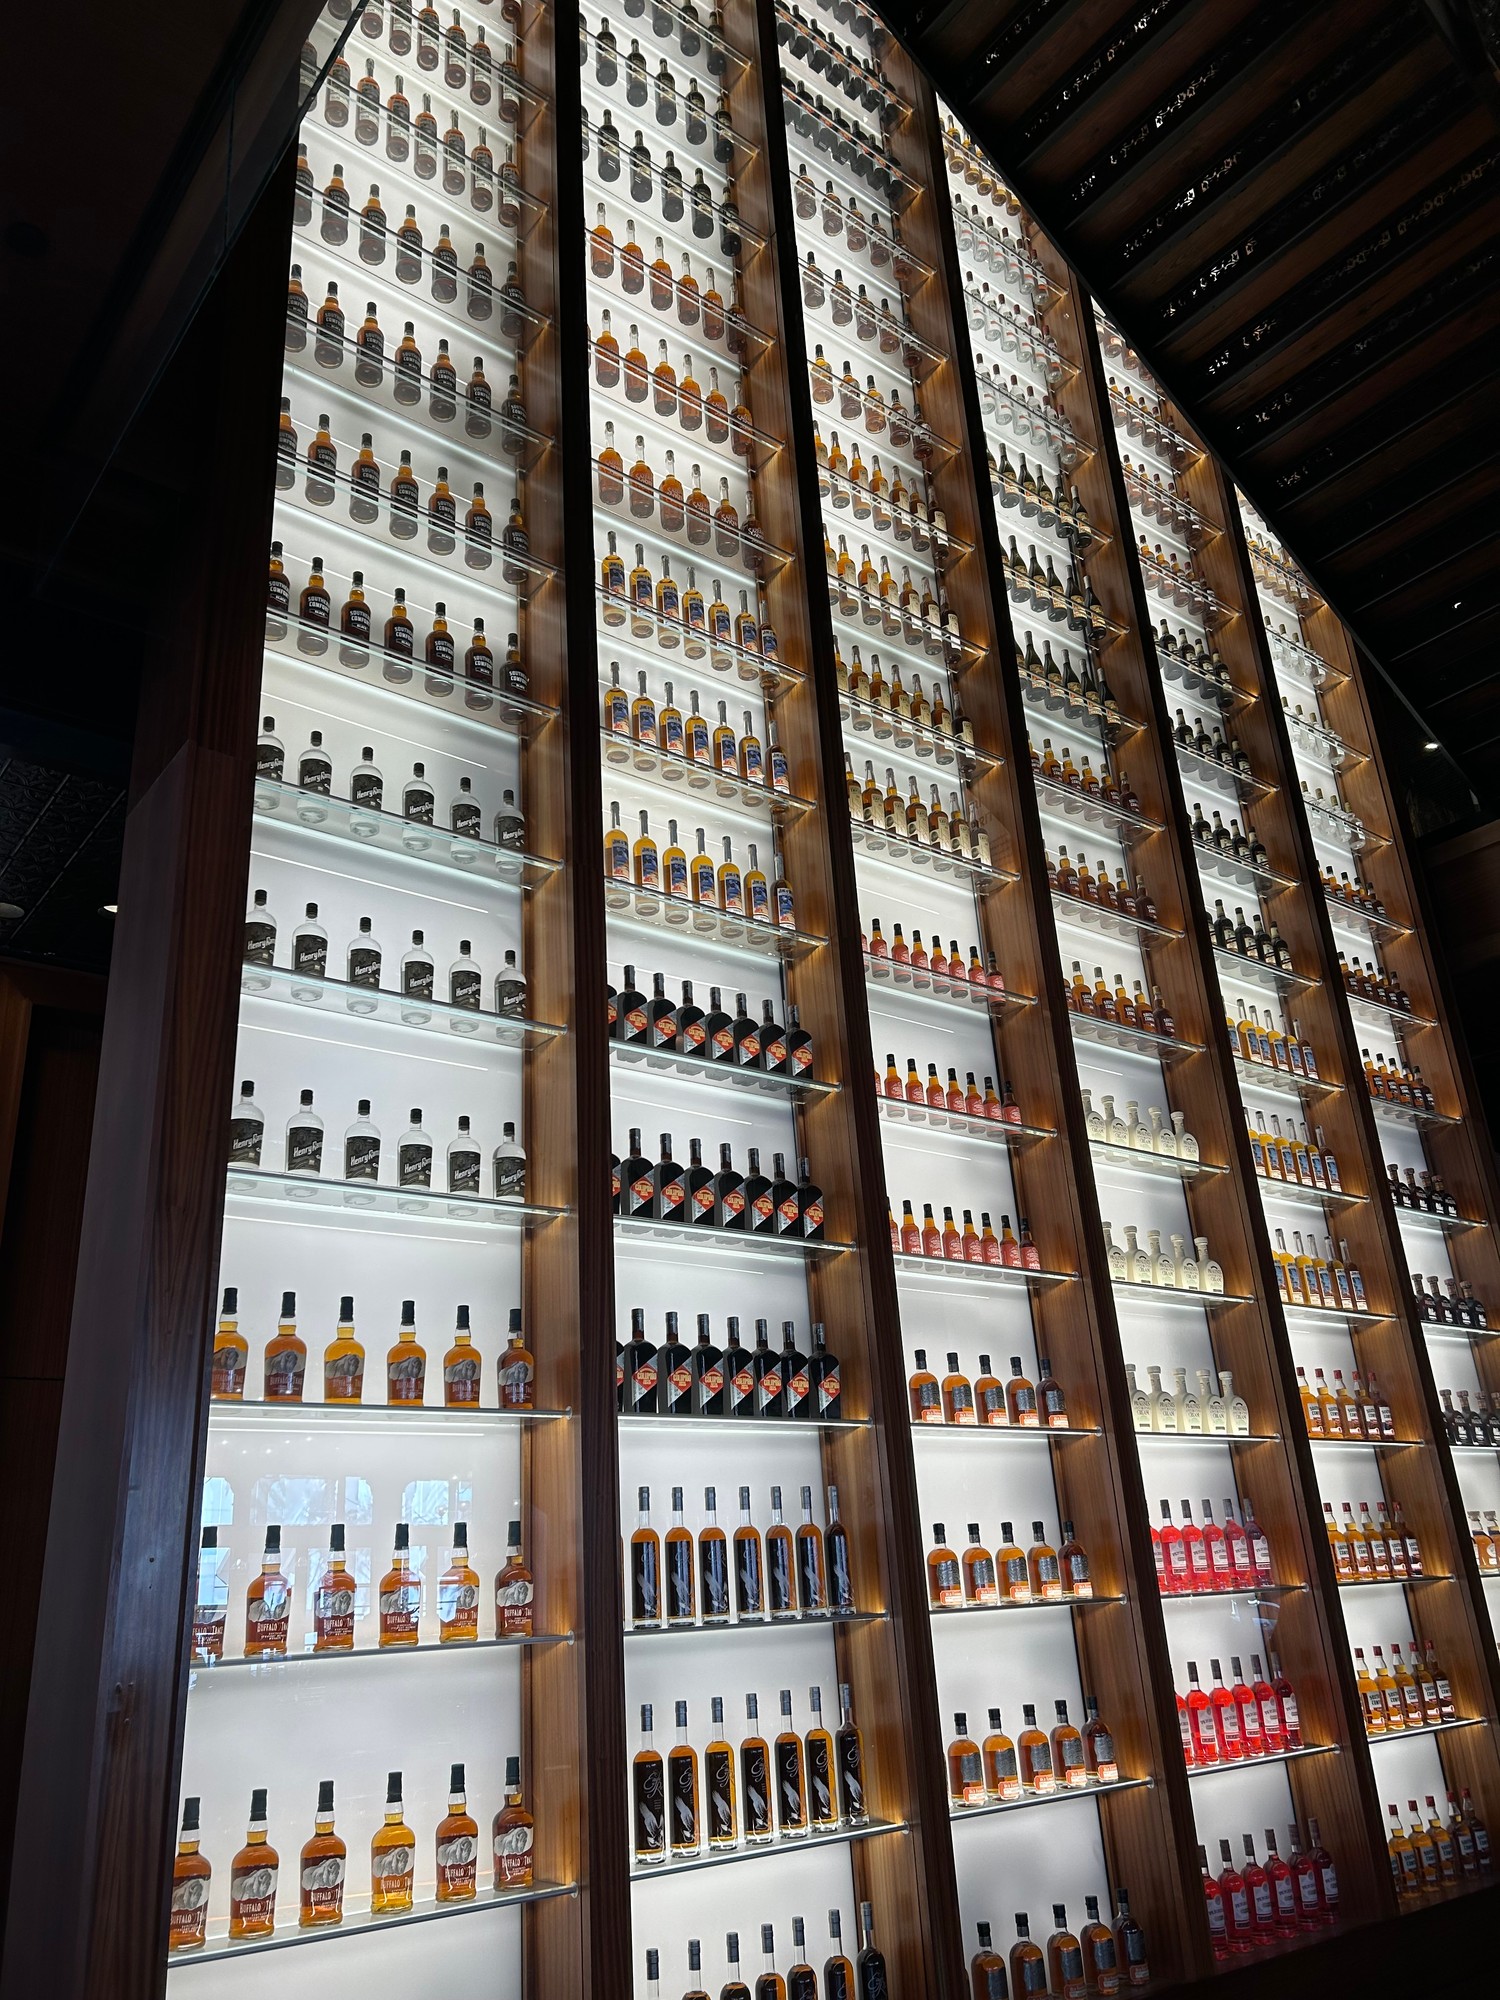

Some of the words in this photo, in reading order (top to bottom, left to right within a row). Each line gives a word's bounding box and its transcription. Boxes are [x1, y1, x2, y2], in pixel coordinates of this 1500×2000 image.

[233, 1135, 253, 1150] Henry
[293, 1144, 313, 1158] Henry
[350, 1152, 369, 1167] Henry
[404, 1160, 422, 1174] Henry
[454, 1166, 472, 1180] Henry
[500, 1172, 518, 1185] Henry
[504, 1607, 523, 1617] BUFFALO
[386, 1614, 406, 1625] BUFFALO
[257, 1622, 278, 1633] BUFFALO
[501, 1857, 521, 1869] BUFFALO
[444, 1866, 465, 1879] BUFFALO
[310, 1891, 332, 1903] BUFFALO
[239, 1901, 262, 1914] BUFFALO
